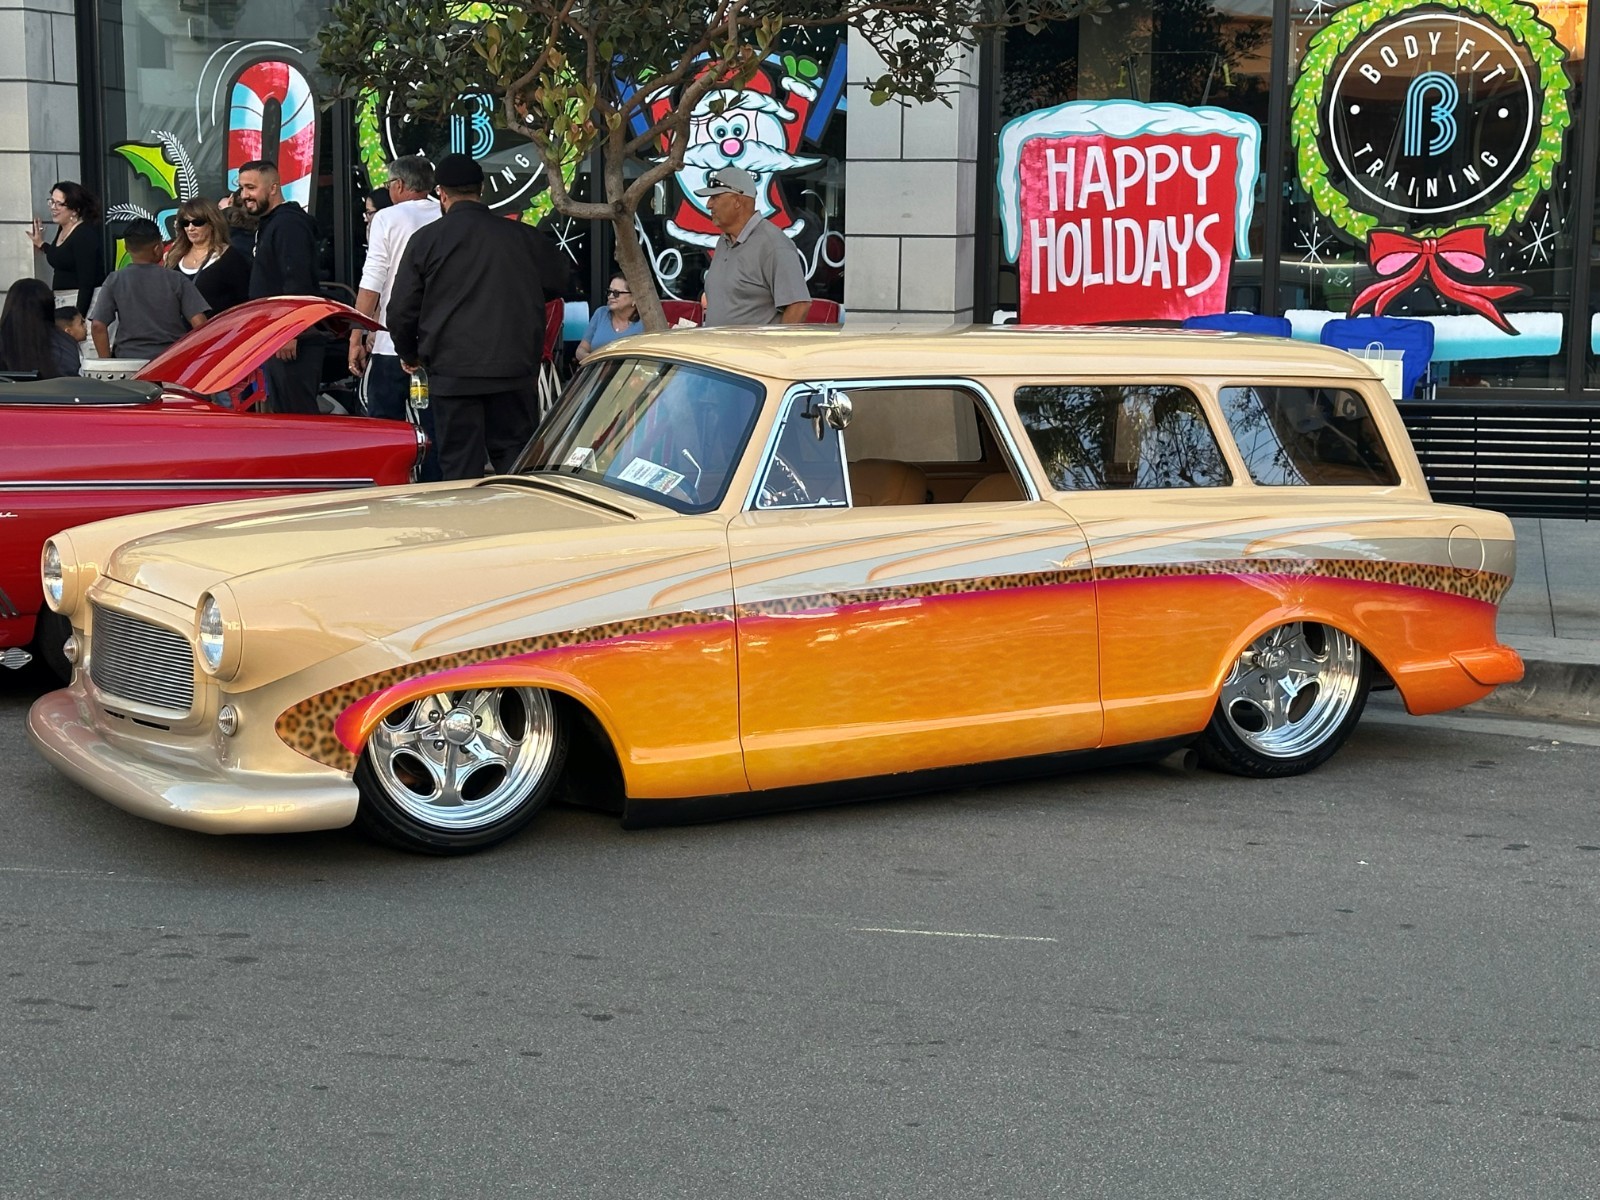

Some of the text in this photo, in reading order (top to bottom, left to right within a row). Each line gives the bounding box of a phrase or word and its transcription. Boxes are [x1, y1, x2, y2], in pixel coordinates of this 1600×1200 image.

[1359, 32, 1507, 85] BODY FIT
[1046, 144, 1221, 212] HAPPY
[1353, 142, 1499, 198] TRAINING
[1029, 212, 1221, 298] HOLIDAYS
